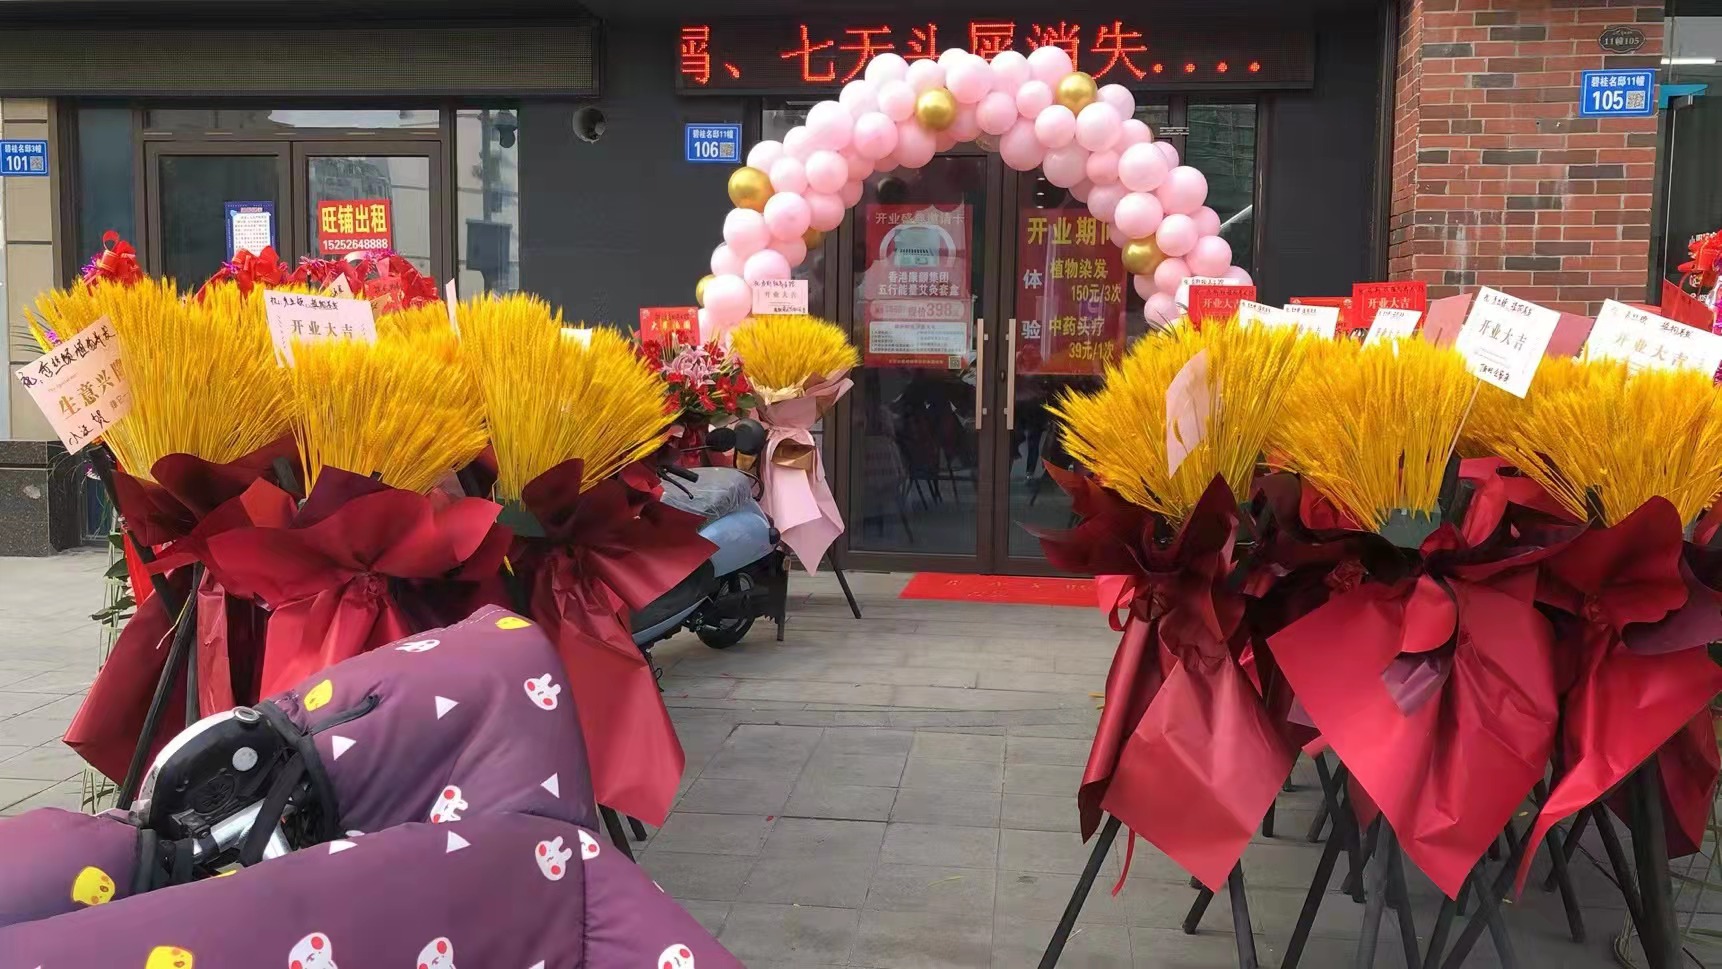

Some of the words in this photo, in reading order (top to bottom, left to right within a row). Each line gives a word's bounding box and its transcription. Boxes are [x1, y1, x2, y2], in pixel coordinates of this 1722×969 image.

[1592, 90, 1624, 110] 105
[694, 141, 719, 158] 106
[6, 155, 28, 171] 101
[321, 204, 387, 234] 旺铺出租
[322, 238, 389, 251] 15252648888
[1050, 258, 1108, 280] 植物染发
[1071, 283, 1122, 303] 150元/3次
[1368, 297, 1410, 309] 开业大吉
[1049, 316, 1105, 337] 中药头疗
[1479, 319, 1528, 352] 开业大吉
[1069, 341, 1114, 360] 39元/1次
